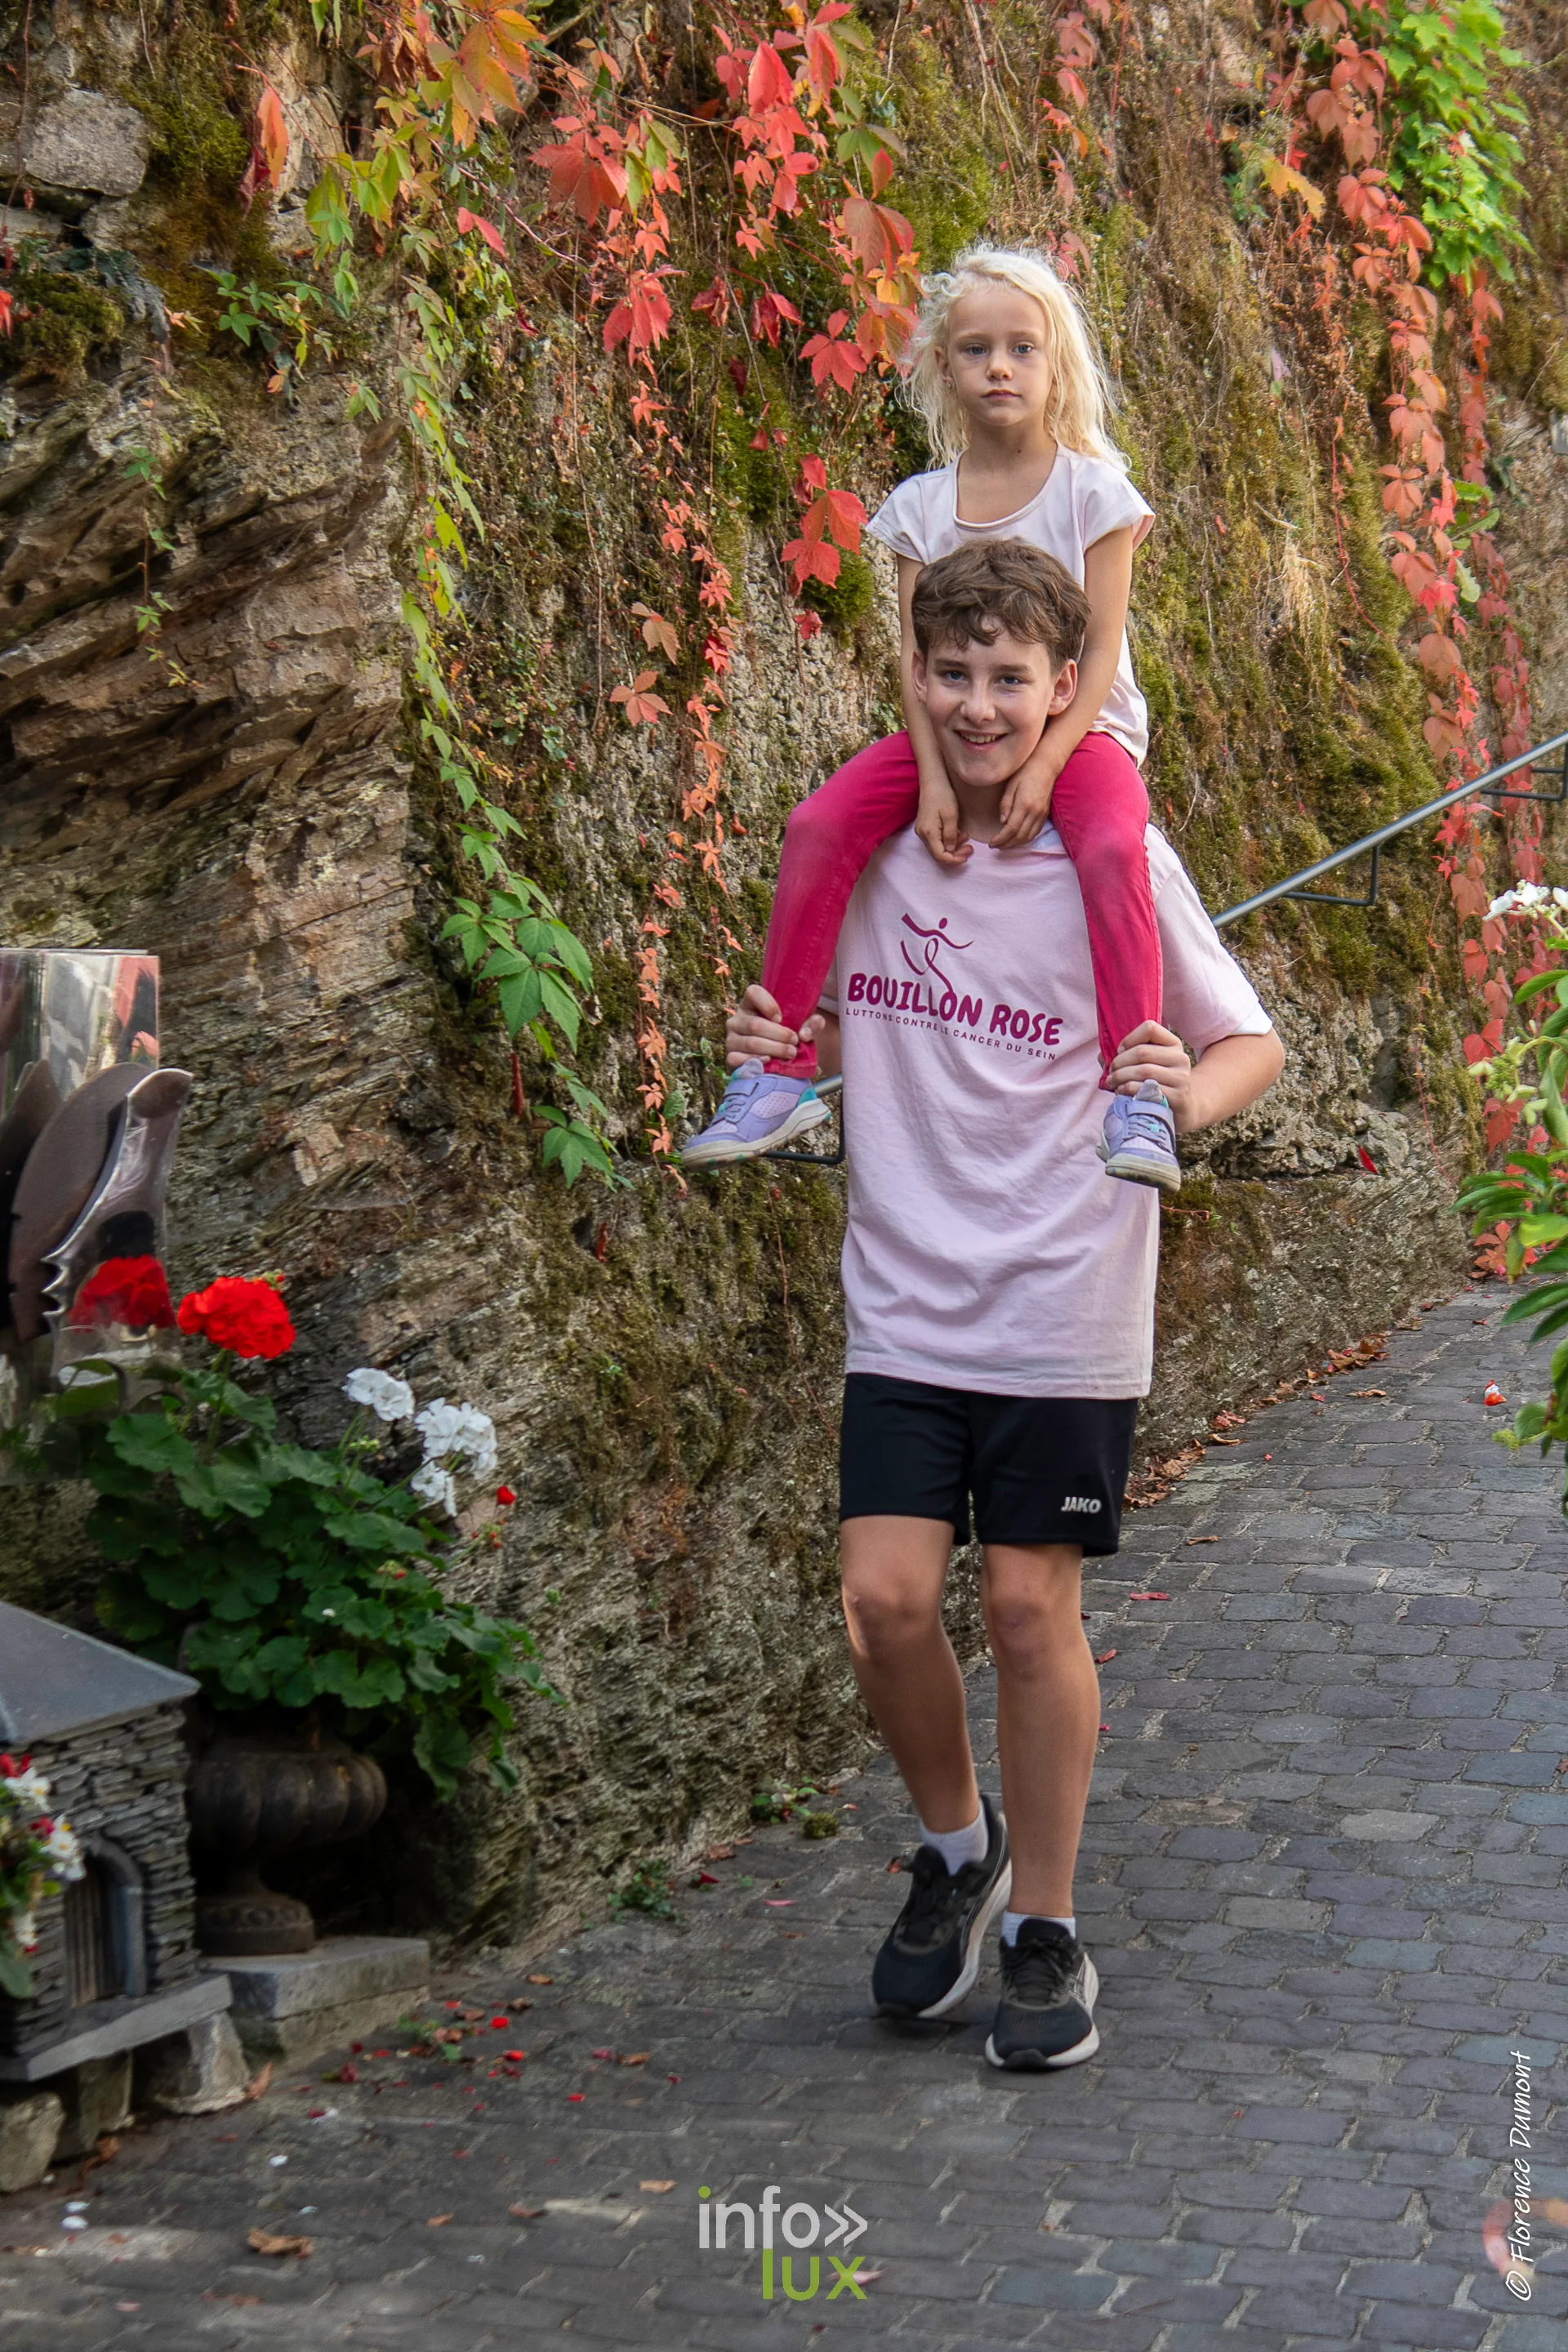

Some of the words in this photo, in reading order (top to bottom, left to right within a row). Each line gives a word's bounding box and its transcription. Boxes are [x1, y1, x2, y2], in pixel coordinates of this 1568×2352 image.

[845, 1008, 893, 1022] LUTTONS
[895, 1015, 938, 1031] CONTRE
[940, 1023, 949, 1036] LE
[953, 1029, 1001, 1048] CANCER
[1006, 1042, 1022, 1053] DU
[1027, 1047, 1057, 1061] SEIN
[847, 973, 983, 1027] BOUILLON
[989, 1004, 1064, 1045] ROSE
[1061, 1496, 1102, 1514] JAKO
